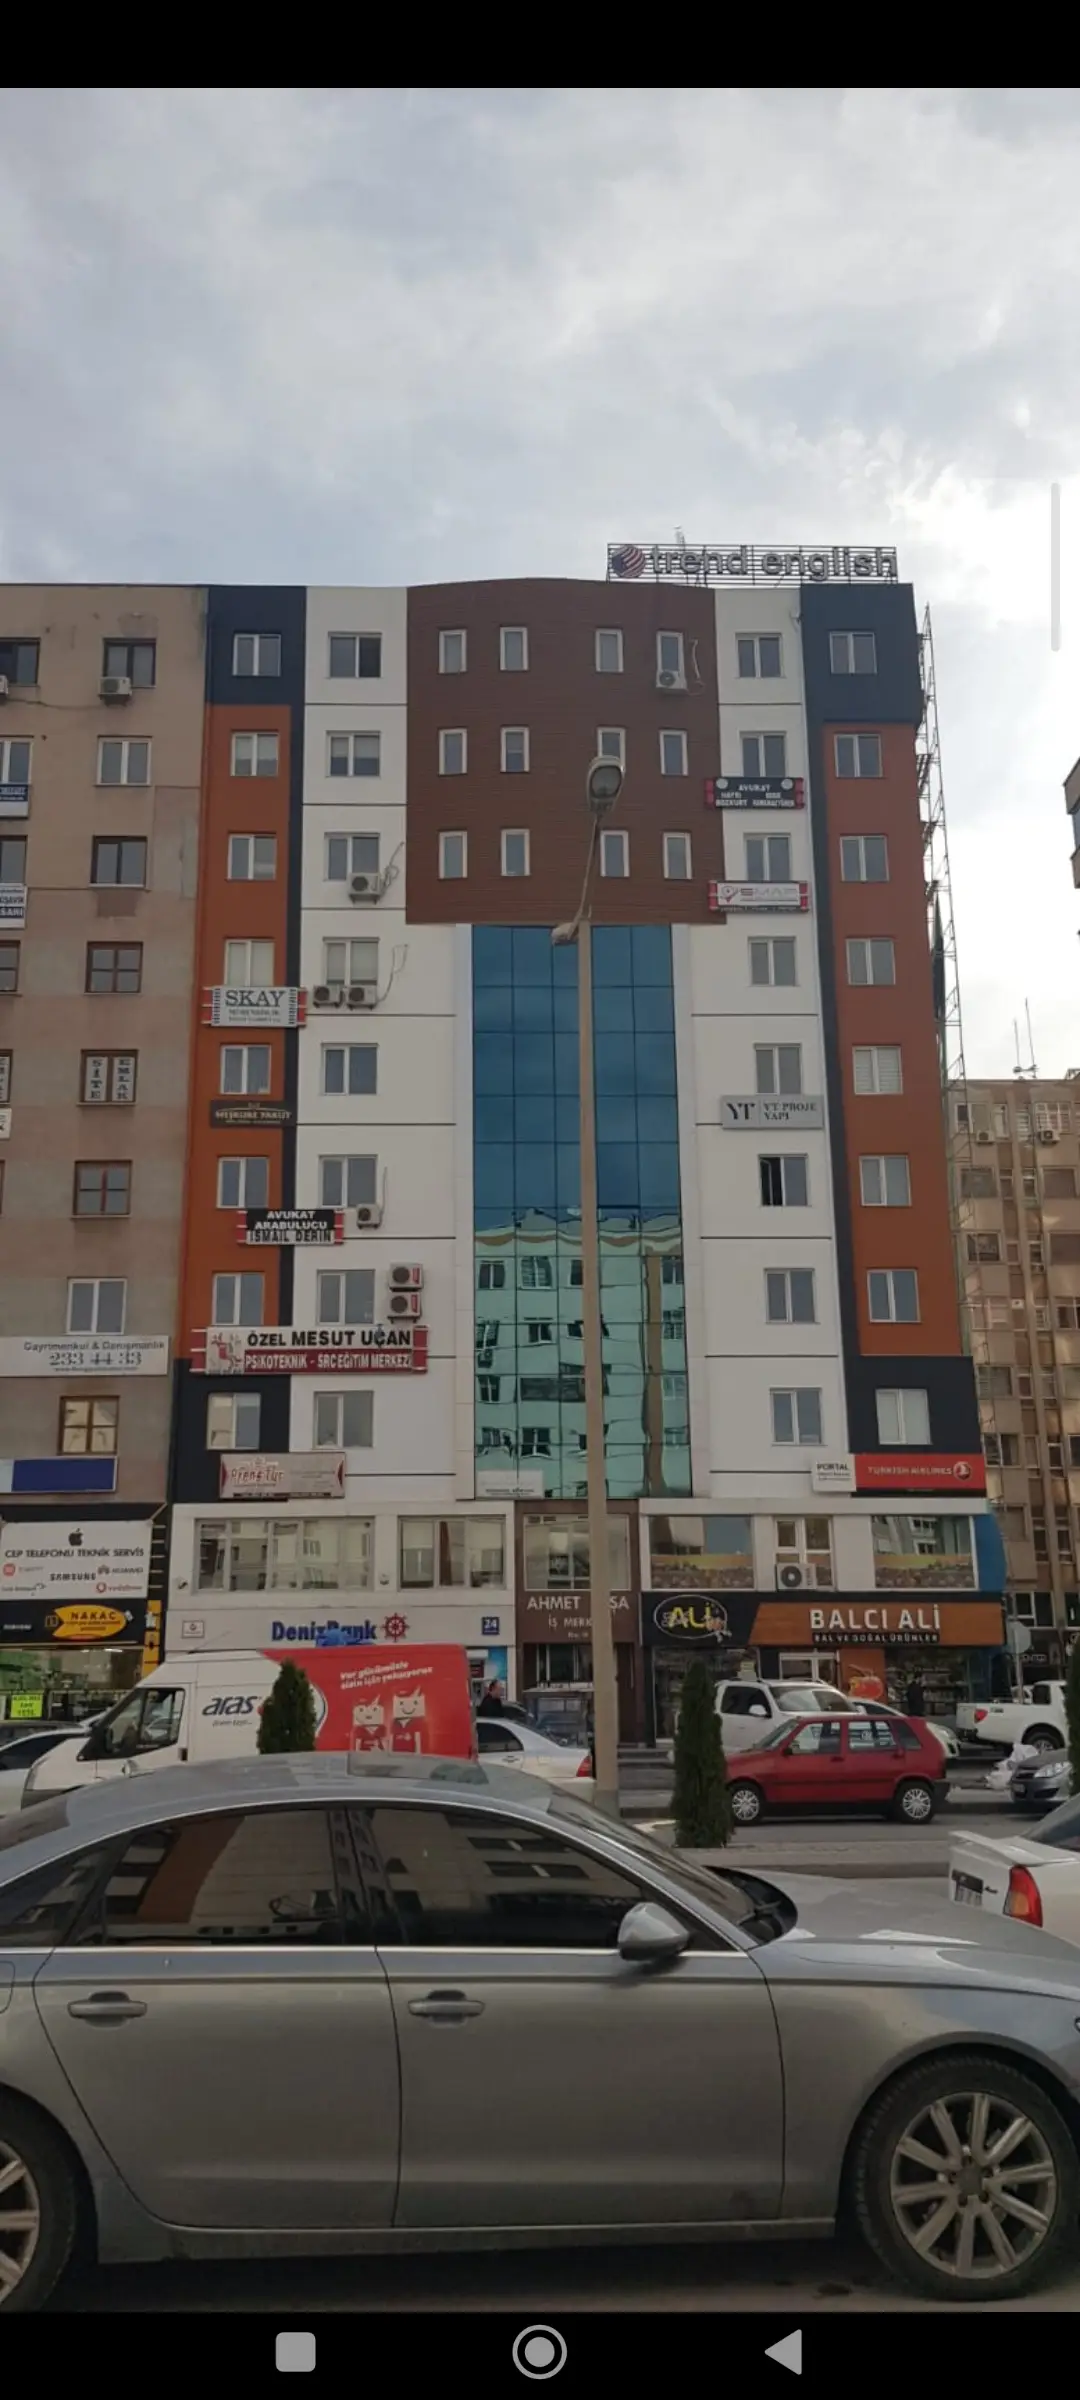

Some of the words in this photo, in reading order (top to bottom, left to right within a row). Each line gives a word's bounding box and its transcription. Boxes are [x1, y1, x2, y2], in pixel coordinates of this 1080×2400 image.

[650, 546, 748, 575] trend
[761, 547, 898, 581] english
[225, 989, 286, 1008] SKAY
[726, 1103, 756, 1120] YT
[763, 1112, 789, 1120] YAPI
[267, 1210, 316, 1219] AVUKAT
[254, 1221, 328, 1230] ARABULUCU
[247, 1330, 287, 1346] ÖZEL
[291, 1330, 355, 1346] MESUT
[4, 1549, 24, 1558] CEP
[25, 1549, 75, 1558] TELEFONU
[50, 1572, 96, 1581] SAMSUNG
[527, 1596, 580, 1610] AHMET
[809, 1609, 888, 1629] BALCI
[898, 1604, 940, 1629] ALİ
[202, 1695, 258, 1716] aras
